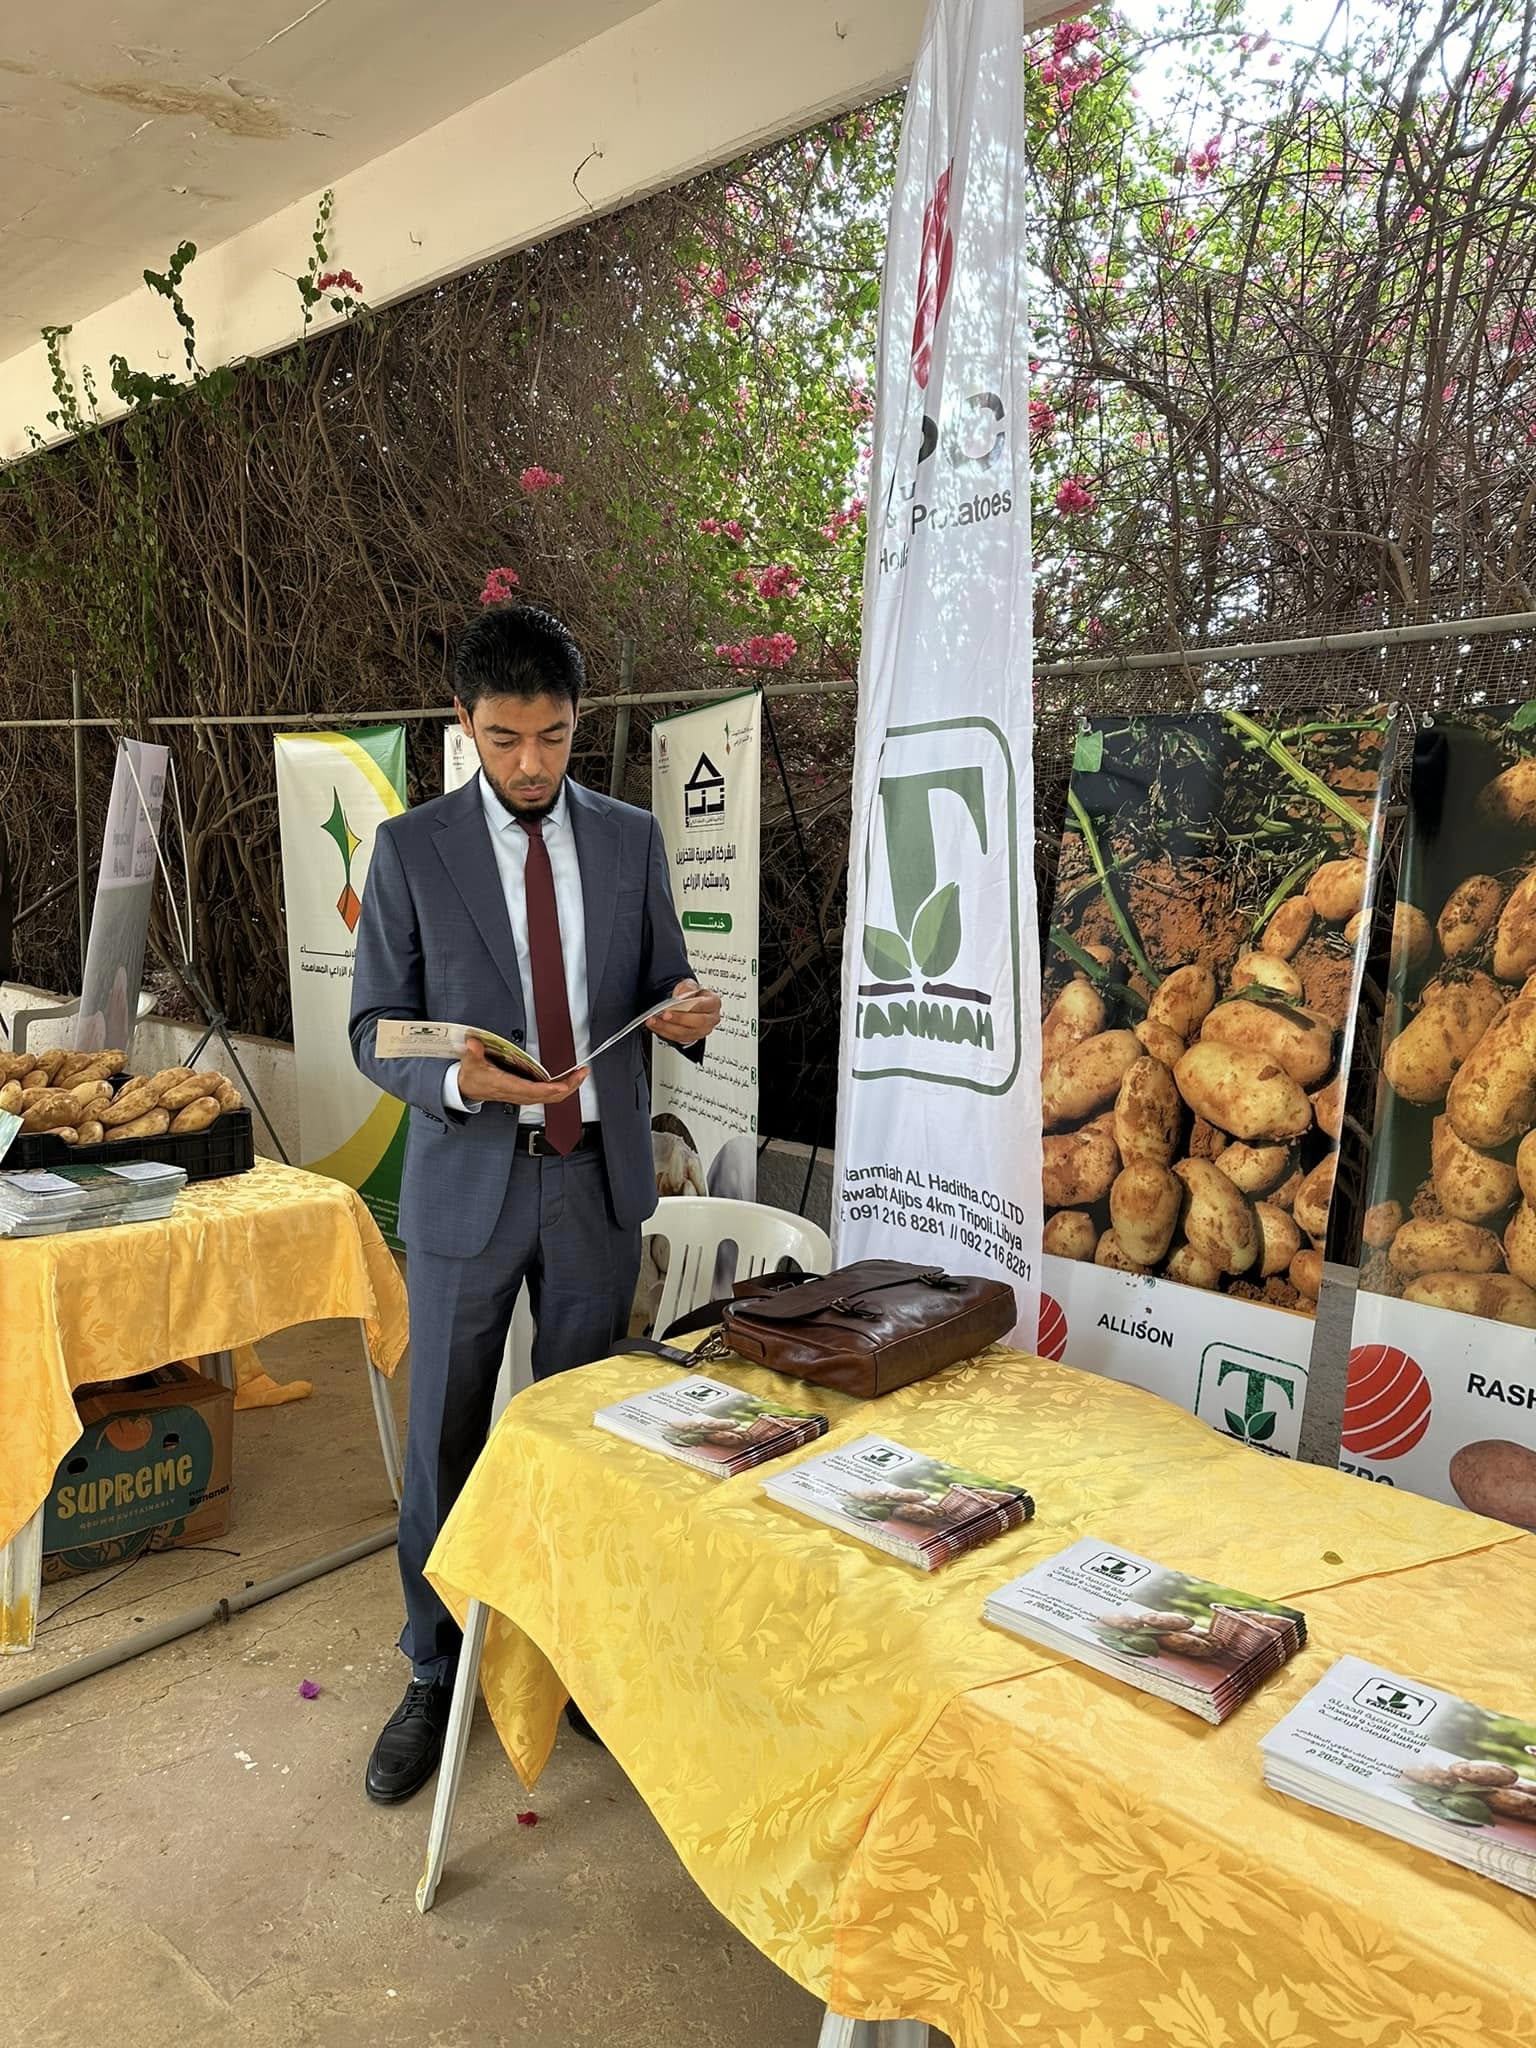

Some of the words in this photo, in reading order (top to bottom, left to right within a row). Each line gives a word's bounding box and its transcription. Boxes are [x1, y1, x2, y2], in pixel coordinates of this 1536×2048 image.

[905, 1170, 926, 1188] AL
[928, 1173, 1025, 1226] Haditha.CO.LTD
[926, 1196, 955, 1218] 4km
[850, 1204, 879, 1221] 091
[882, 1207, 907, 1228] 216
[911, 1215, 945, 1237] 8281
[960, 1228, 982, 1253] 092
[984, 1239, 1005, 1265] 216
[1006, 1252, 1032, 1282] 8281
[1097, 1313, 1174, 1348] ALLISON
